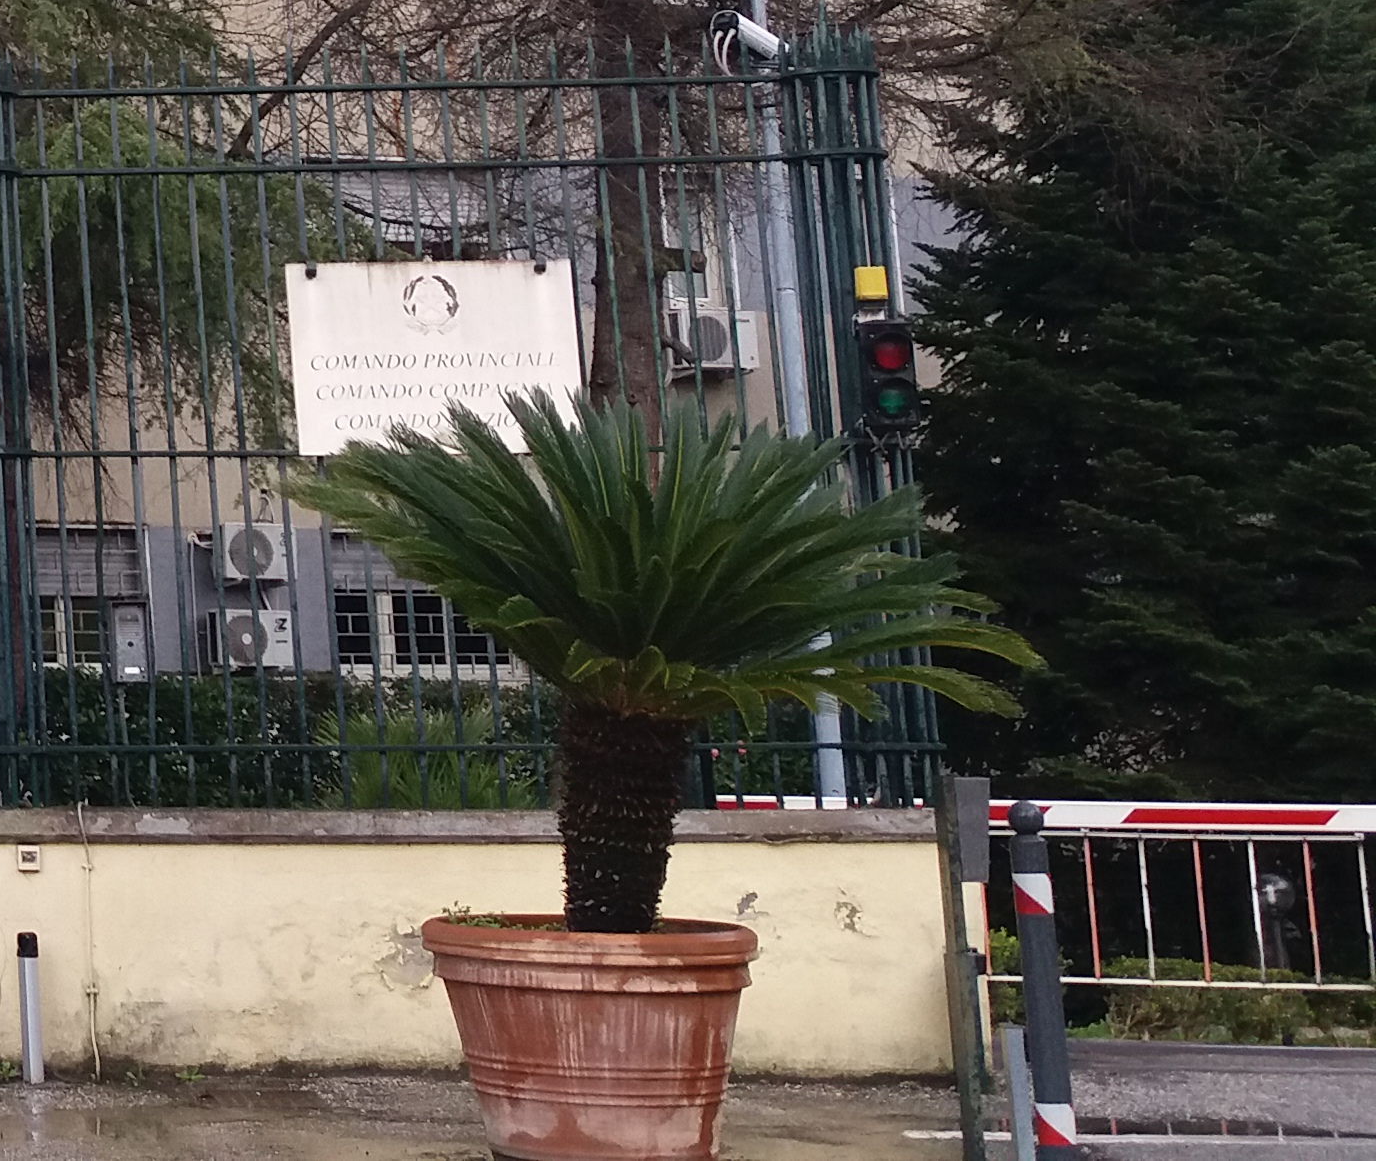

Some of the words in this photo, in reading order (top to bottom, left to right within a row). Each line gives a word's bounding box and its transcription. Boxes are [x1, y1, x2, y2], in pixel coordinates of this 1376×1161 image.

[310, 353, 417, 371] COMANDO
[423, 351, 559, 369] PROVINCIALE
[315, 383, 423, 400] COMANDO
